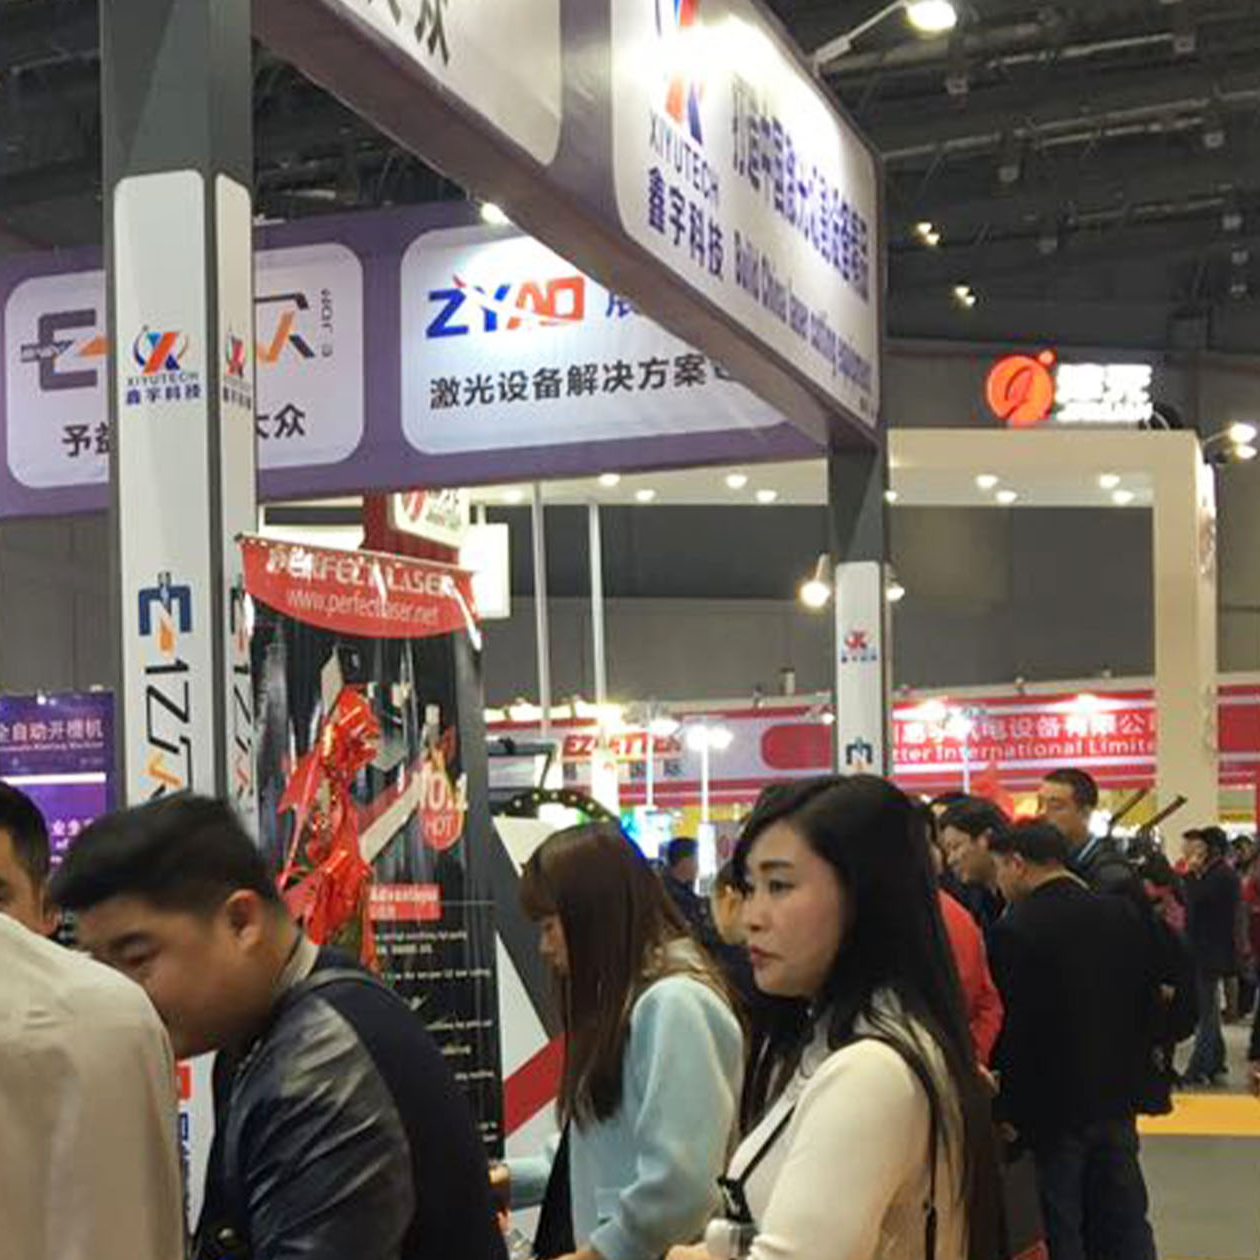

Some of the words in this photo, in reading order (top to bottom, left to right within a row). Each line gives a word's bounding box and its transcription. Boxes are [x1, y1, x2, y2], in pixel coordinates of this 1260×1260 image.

[430, 353, 732, 409] 激光设备解决方案
